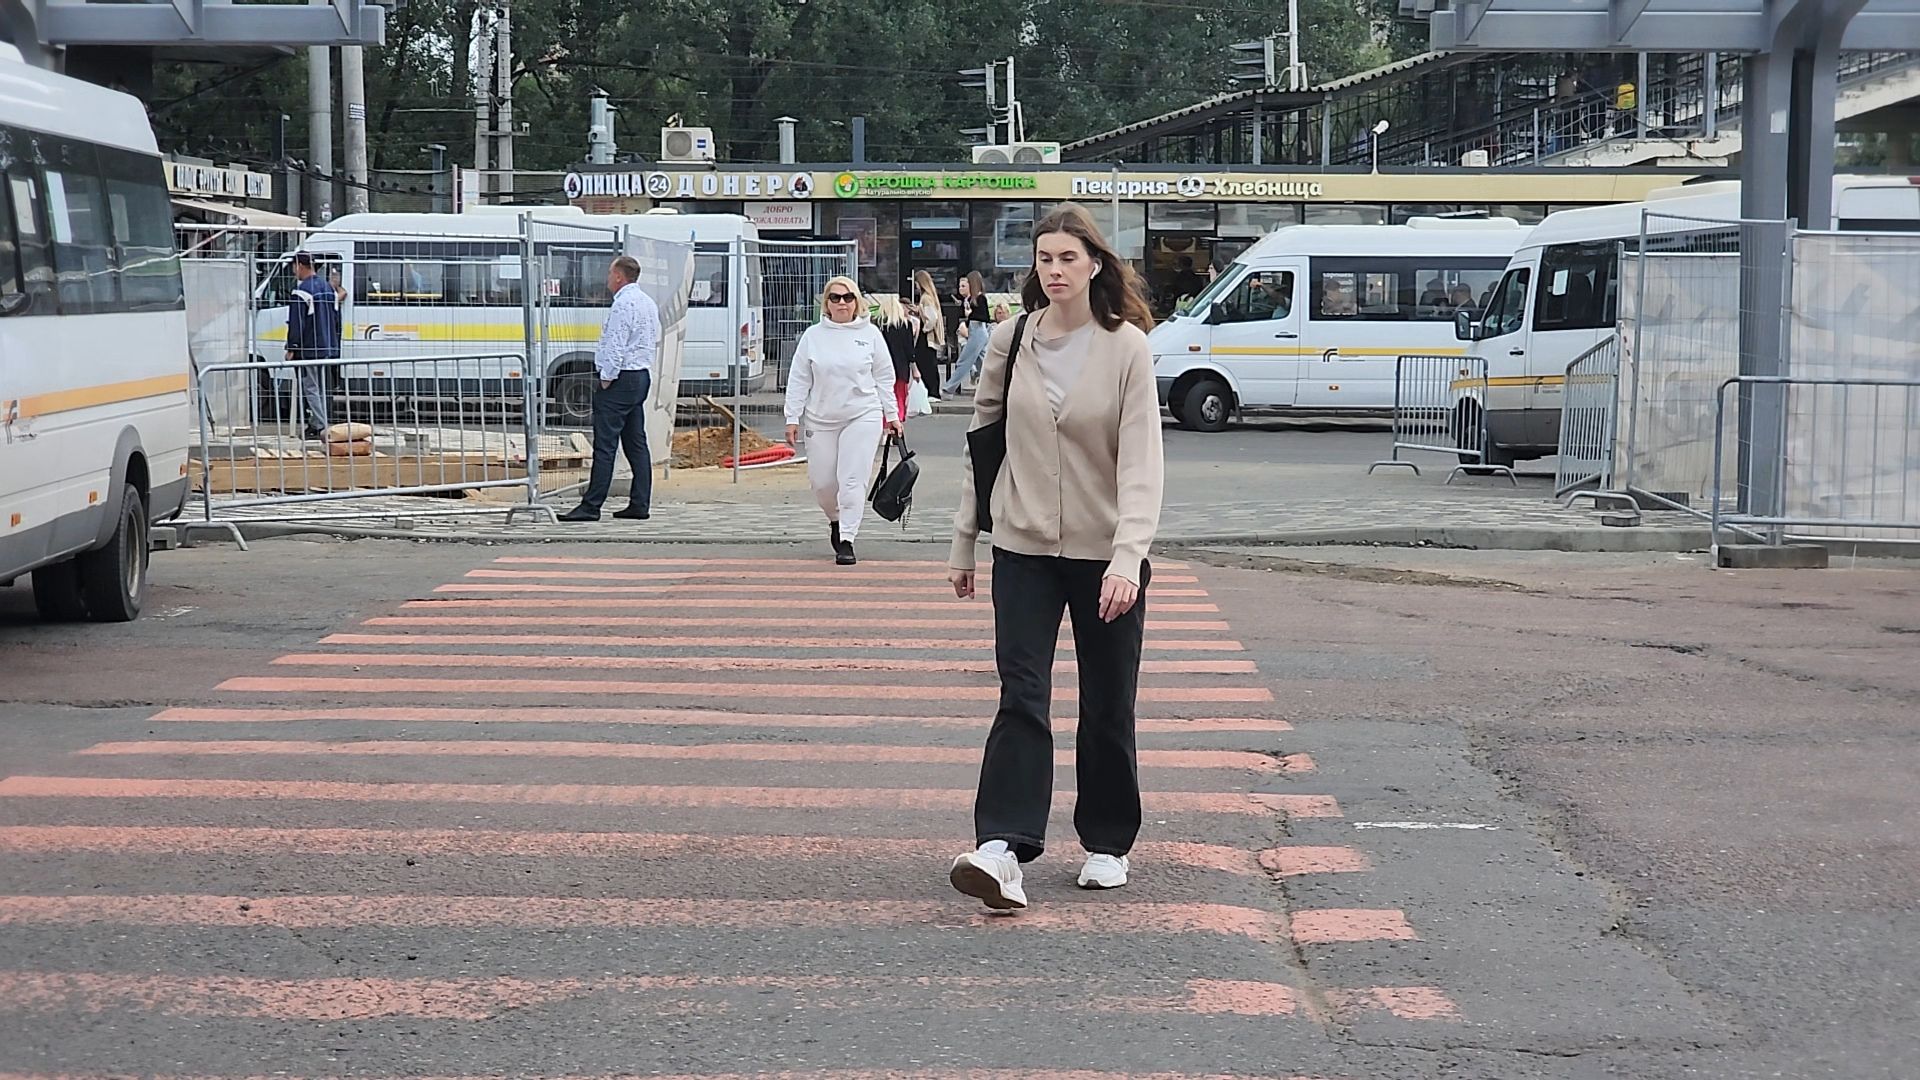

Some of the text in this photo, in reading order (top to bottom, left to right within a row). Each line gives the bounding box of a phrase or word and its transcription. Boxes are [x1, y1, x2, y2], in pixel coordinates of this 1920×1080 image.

[582, 174, 783, 198] ПИЦЦА 24 ДОНЕР
[864, 176, 1036, 188] КРОШКА КАРТОШКА
[1071, 177, 1323, 199] Пекарня Хлебница
[763, 204, 793, 213] ДОБРО
